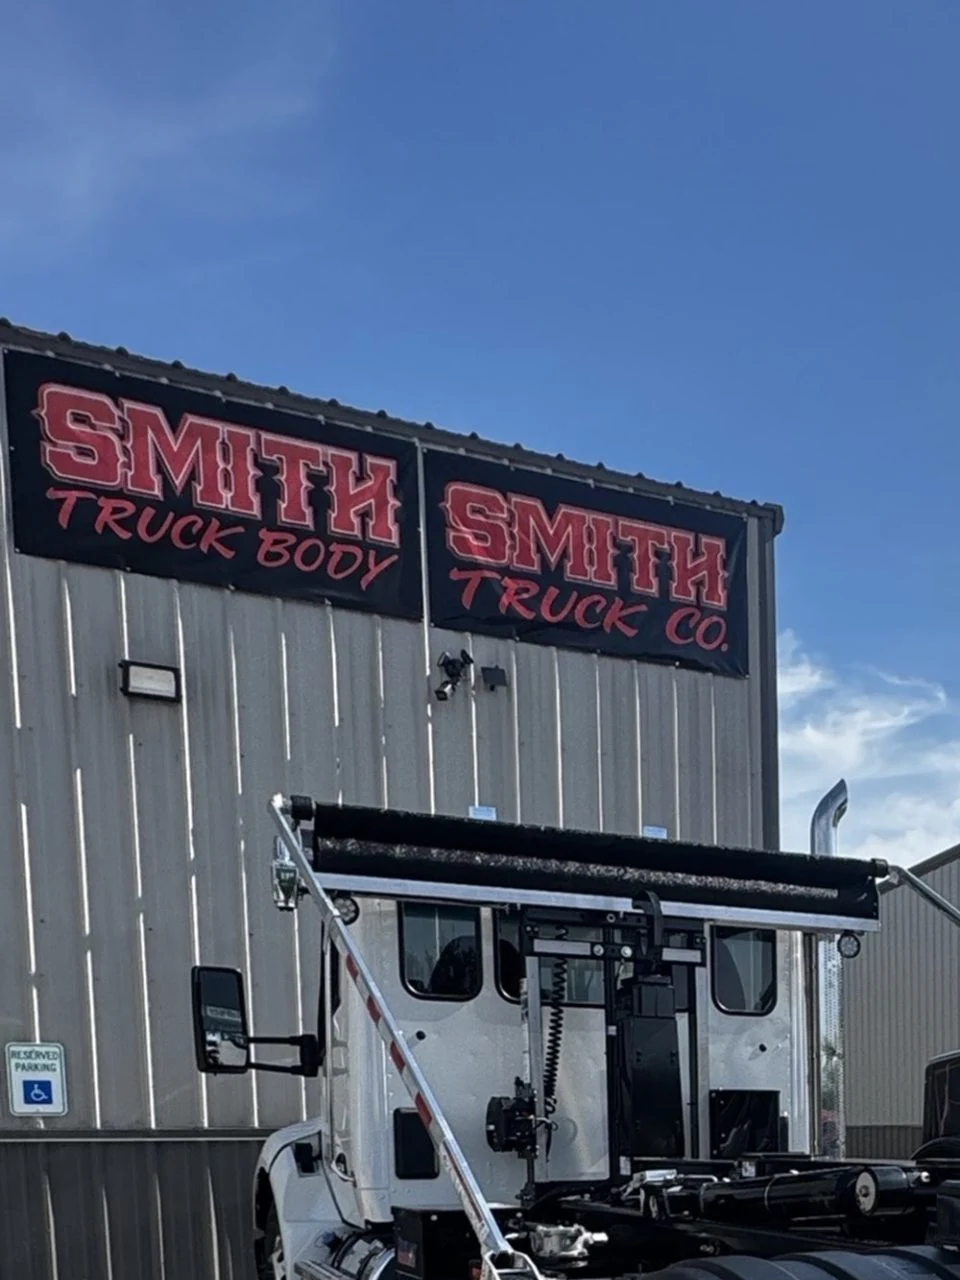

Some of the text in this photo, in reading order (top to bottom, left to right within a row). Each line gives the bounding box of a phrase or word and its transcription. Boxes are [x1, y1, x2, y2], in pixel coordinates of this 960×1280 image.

[32, 382, 401, 548] SMITH
[47, 488, 399, 591] TRUCK BODY
[439, 481, 728, 611] SMITH
[450, 568, 728, 651] TRUCK CO.
[10, 1050, 59, 1061] RESERVED
[15, 1062, 57, 1072] PARKING
